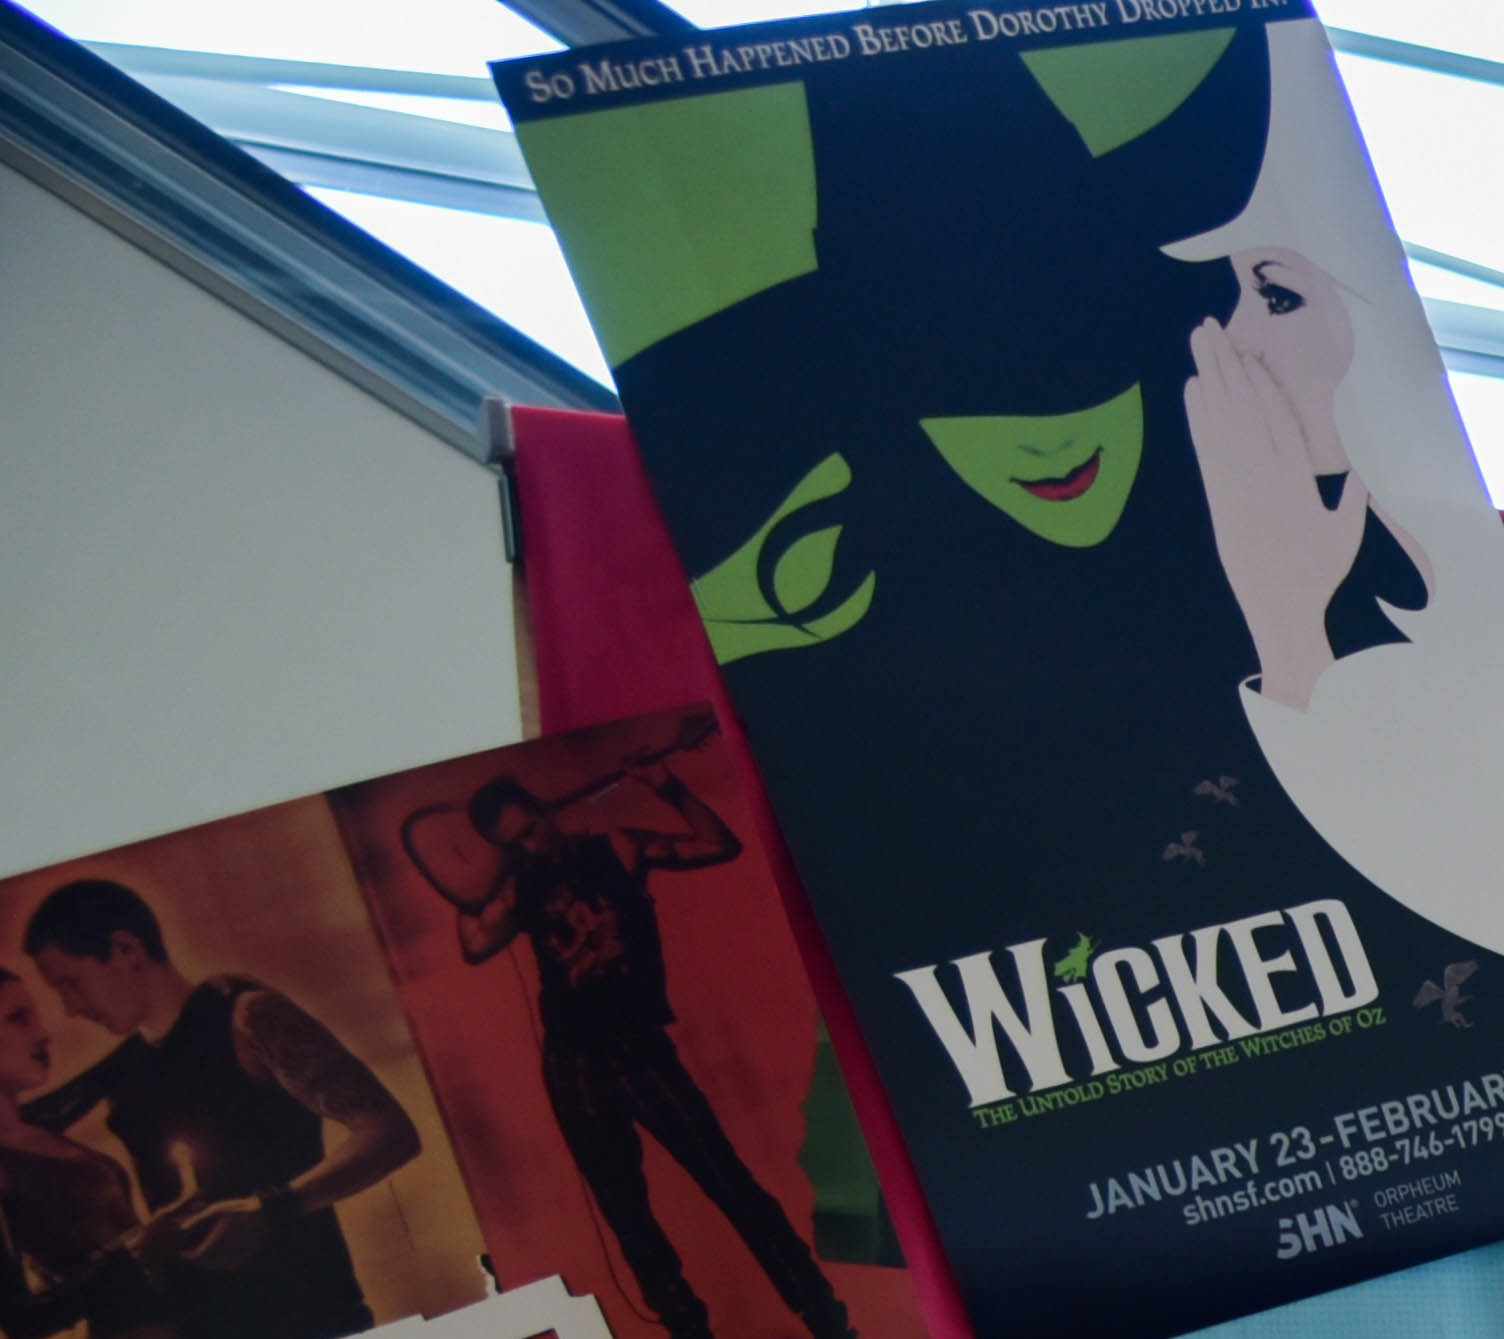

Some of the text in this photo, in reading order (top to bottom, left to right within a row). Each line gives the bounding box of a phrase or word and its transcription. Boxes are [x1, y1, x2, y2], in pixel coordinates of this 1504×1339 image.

[1083, 1139, 1259, 1219] JANUARY
[1182, 1163, 1323, 1226] shnsf.com
[1374, 1170, 1462, 1209] ORPHEUM
[1379, 1195, 1460, 1232] THEATRE
